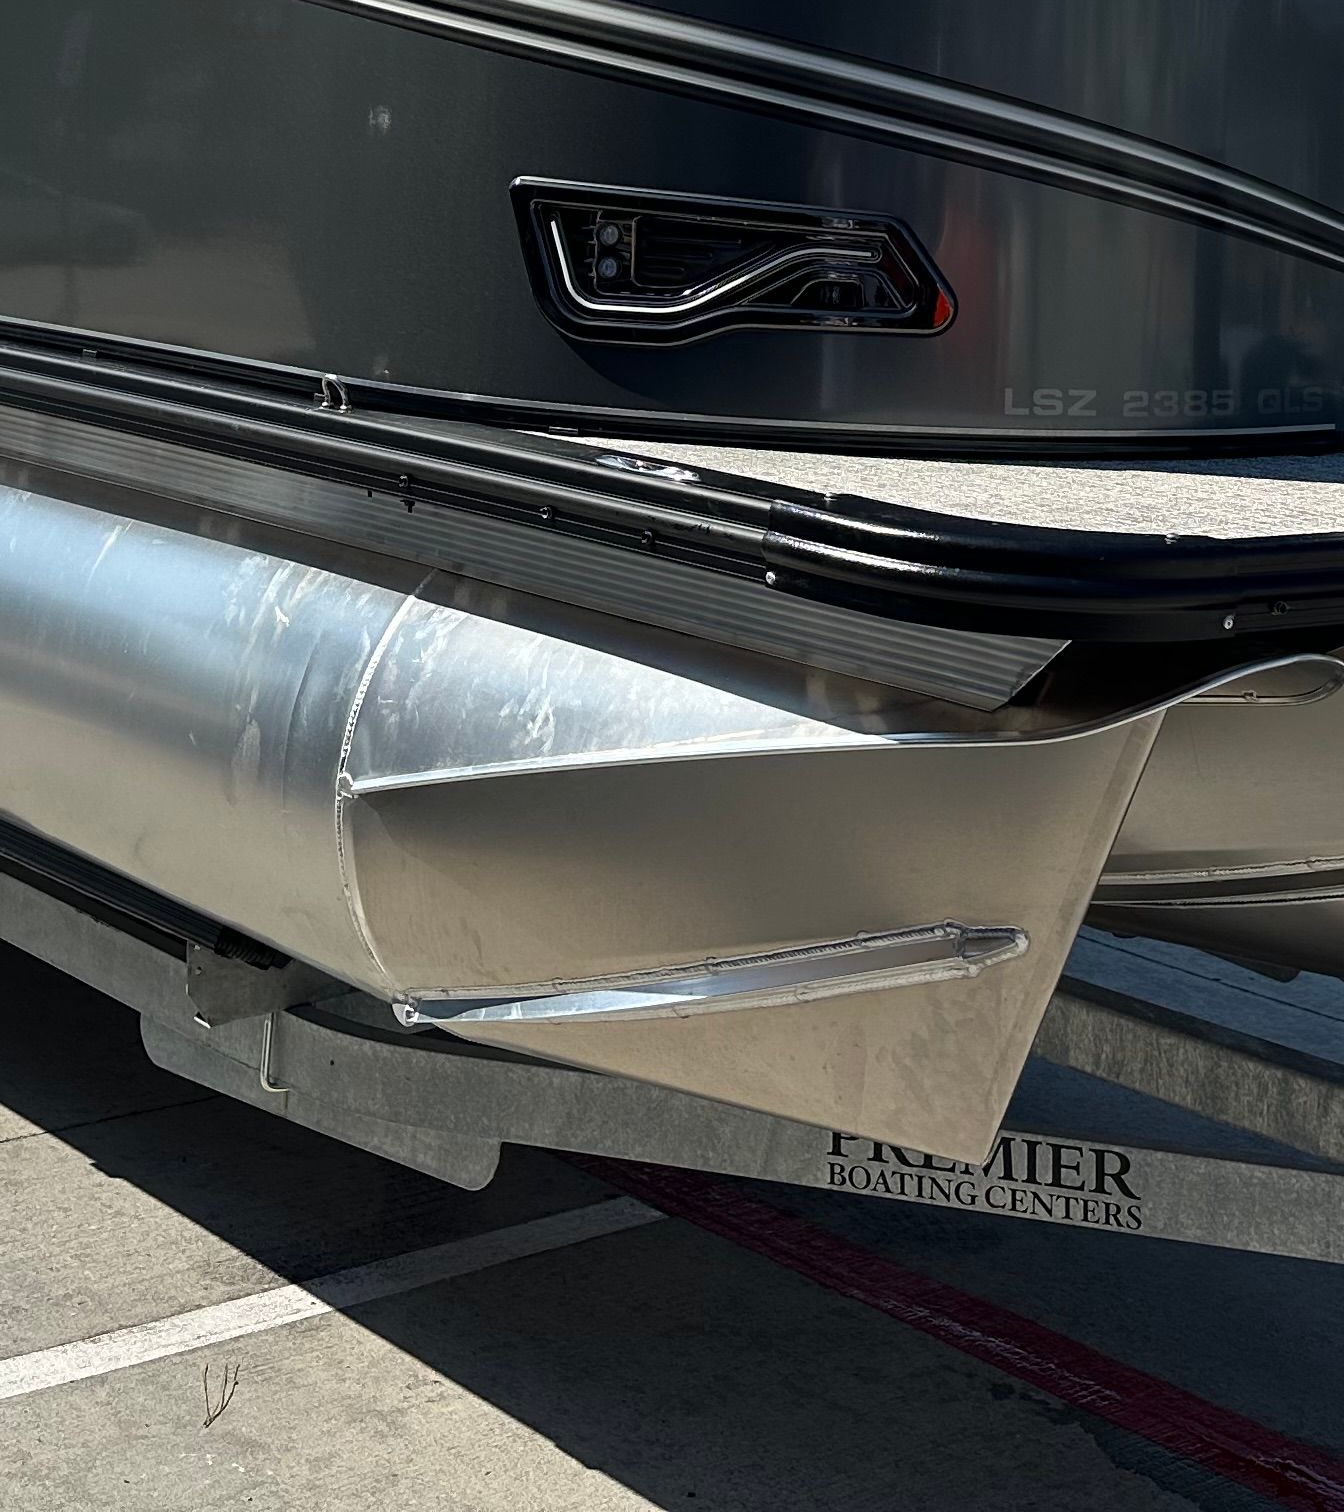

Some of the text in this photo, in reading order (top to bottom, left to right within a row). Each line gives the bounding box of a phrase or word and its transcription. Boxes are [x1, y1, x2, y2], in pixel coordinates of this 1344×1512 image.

[1004, 388, 1097, 416] LSZ
[1122, 389, 1236, 418] 2385
[827, 1162, 1143, 1230] BOATING CENTERS
